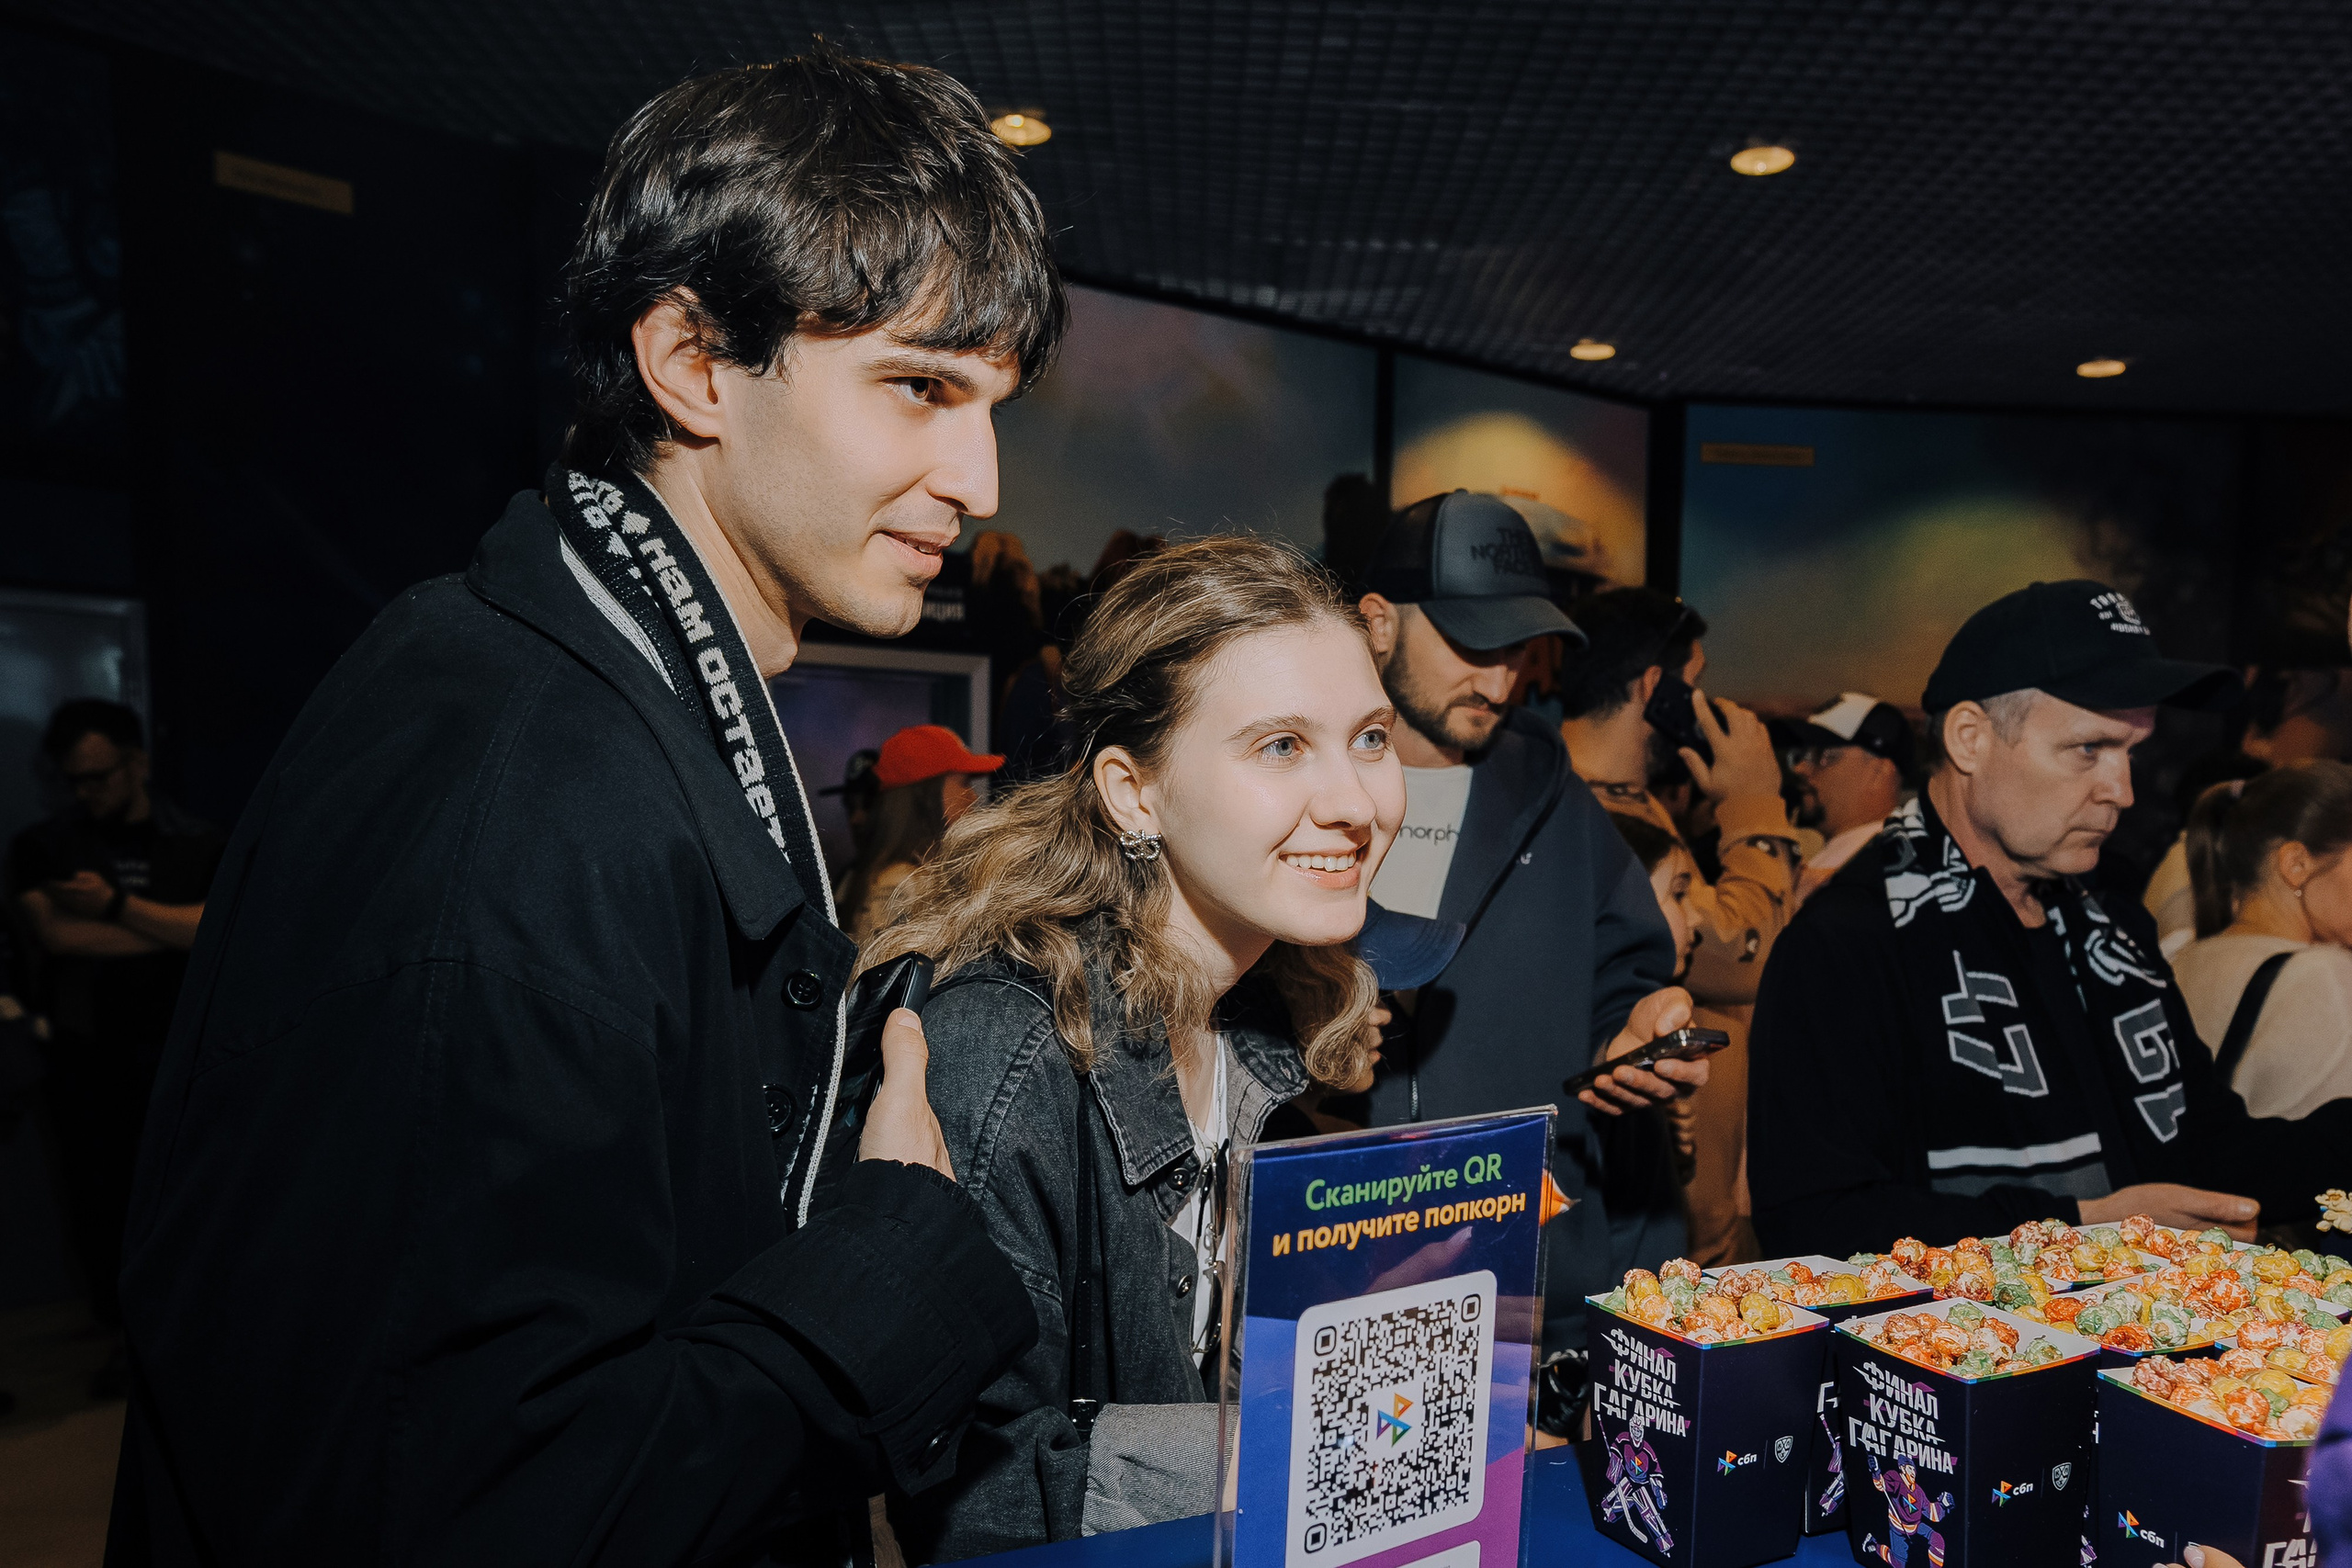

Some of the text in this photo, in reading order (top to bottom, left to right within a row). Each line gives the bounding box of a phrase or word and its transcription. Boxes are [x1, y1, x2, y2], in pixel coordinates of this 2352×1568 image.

[1305, 1153, 1502, 1211] Сканируйте QR
[1272, 1192, 1526, 1257] и получите попкорн
[1600, 1328, 1677, 1384] ФИНАЛ
[1614, 1359, 1681, 1409] КУБКА
[1594, 1382, 1687, 1438] ГАГАРИНА
[1852, 1361, 1939, 1420] ФИНАЛ
[1869, 1393, 1946, 1445] КУБКА
[1849, 1416, 1954, 1475] ГАГАРИНА
